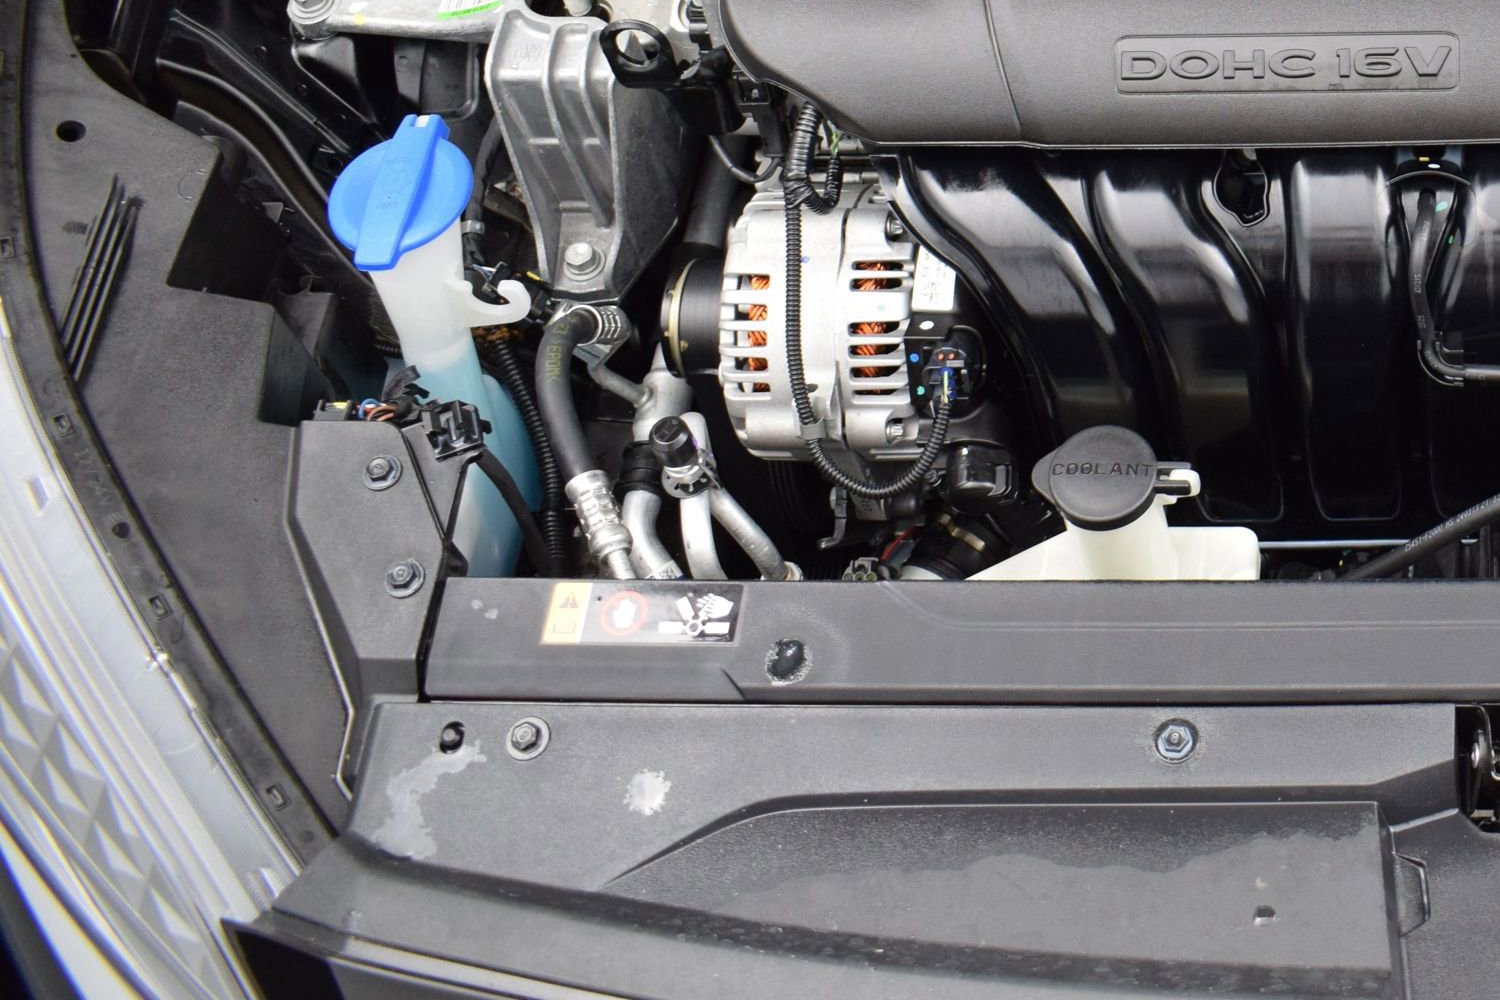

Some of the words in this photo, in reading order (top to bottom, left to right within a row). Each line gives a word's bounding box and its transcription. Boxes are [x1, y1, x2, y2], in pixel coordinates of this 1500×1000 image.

[1121, 48, 1317, 81] DOHC
[1336, 45, 1452, 78] 16V
[1051, 462, 1153, 478] COOLANT
